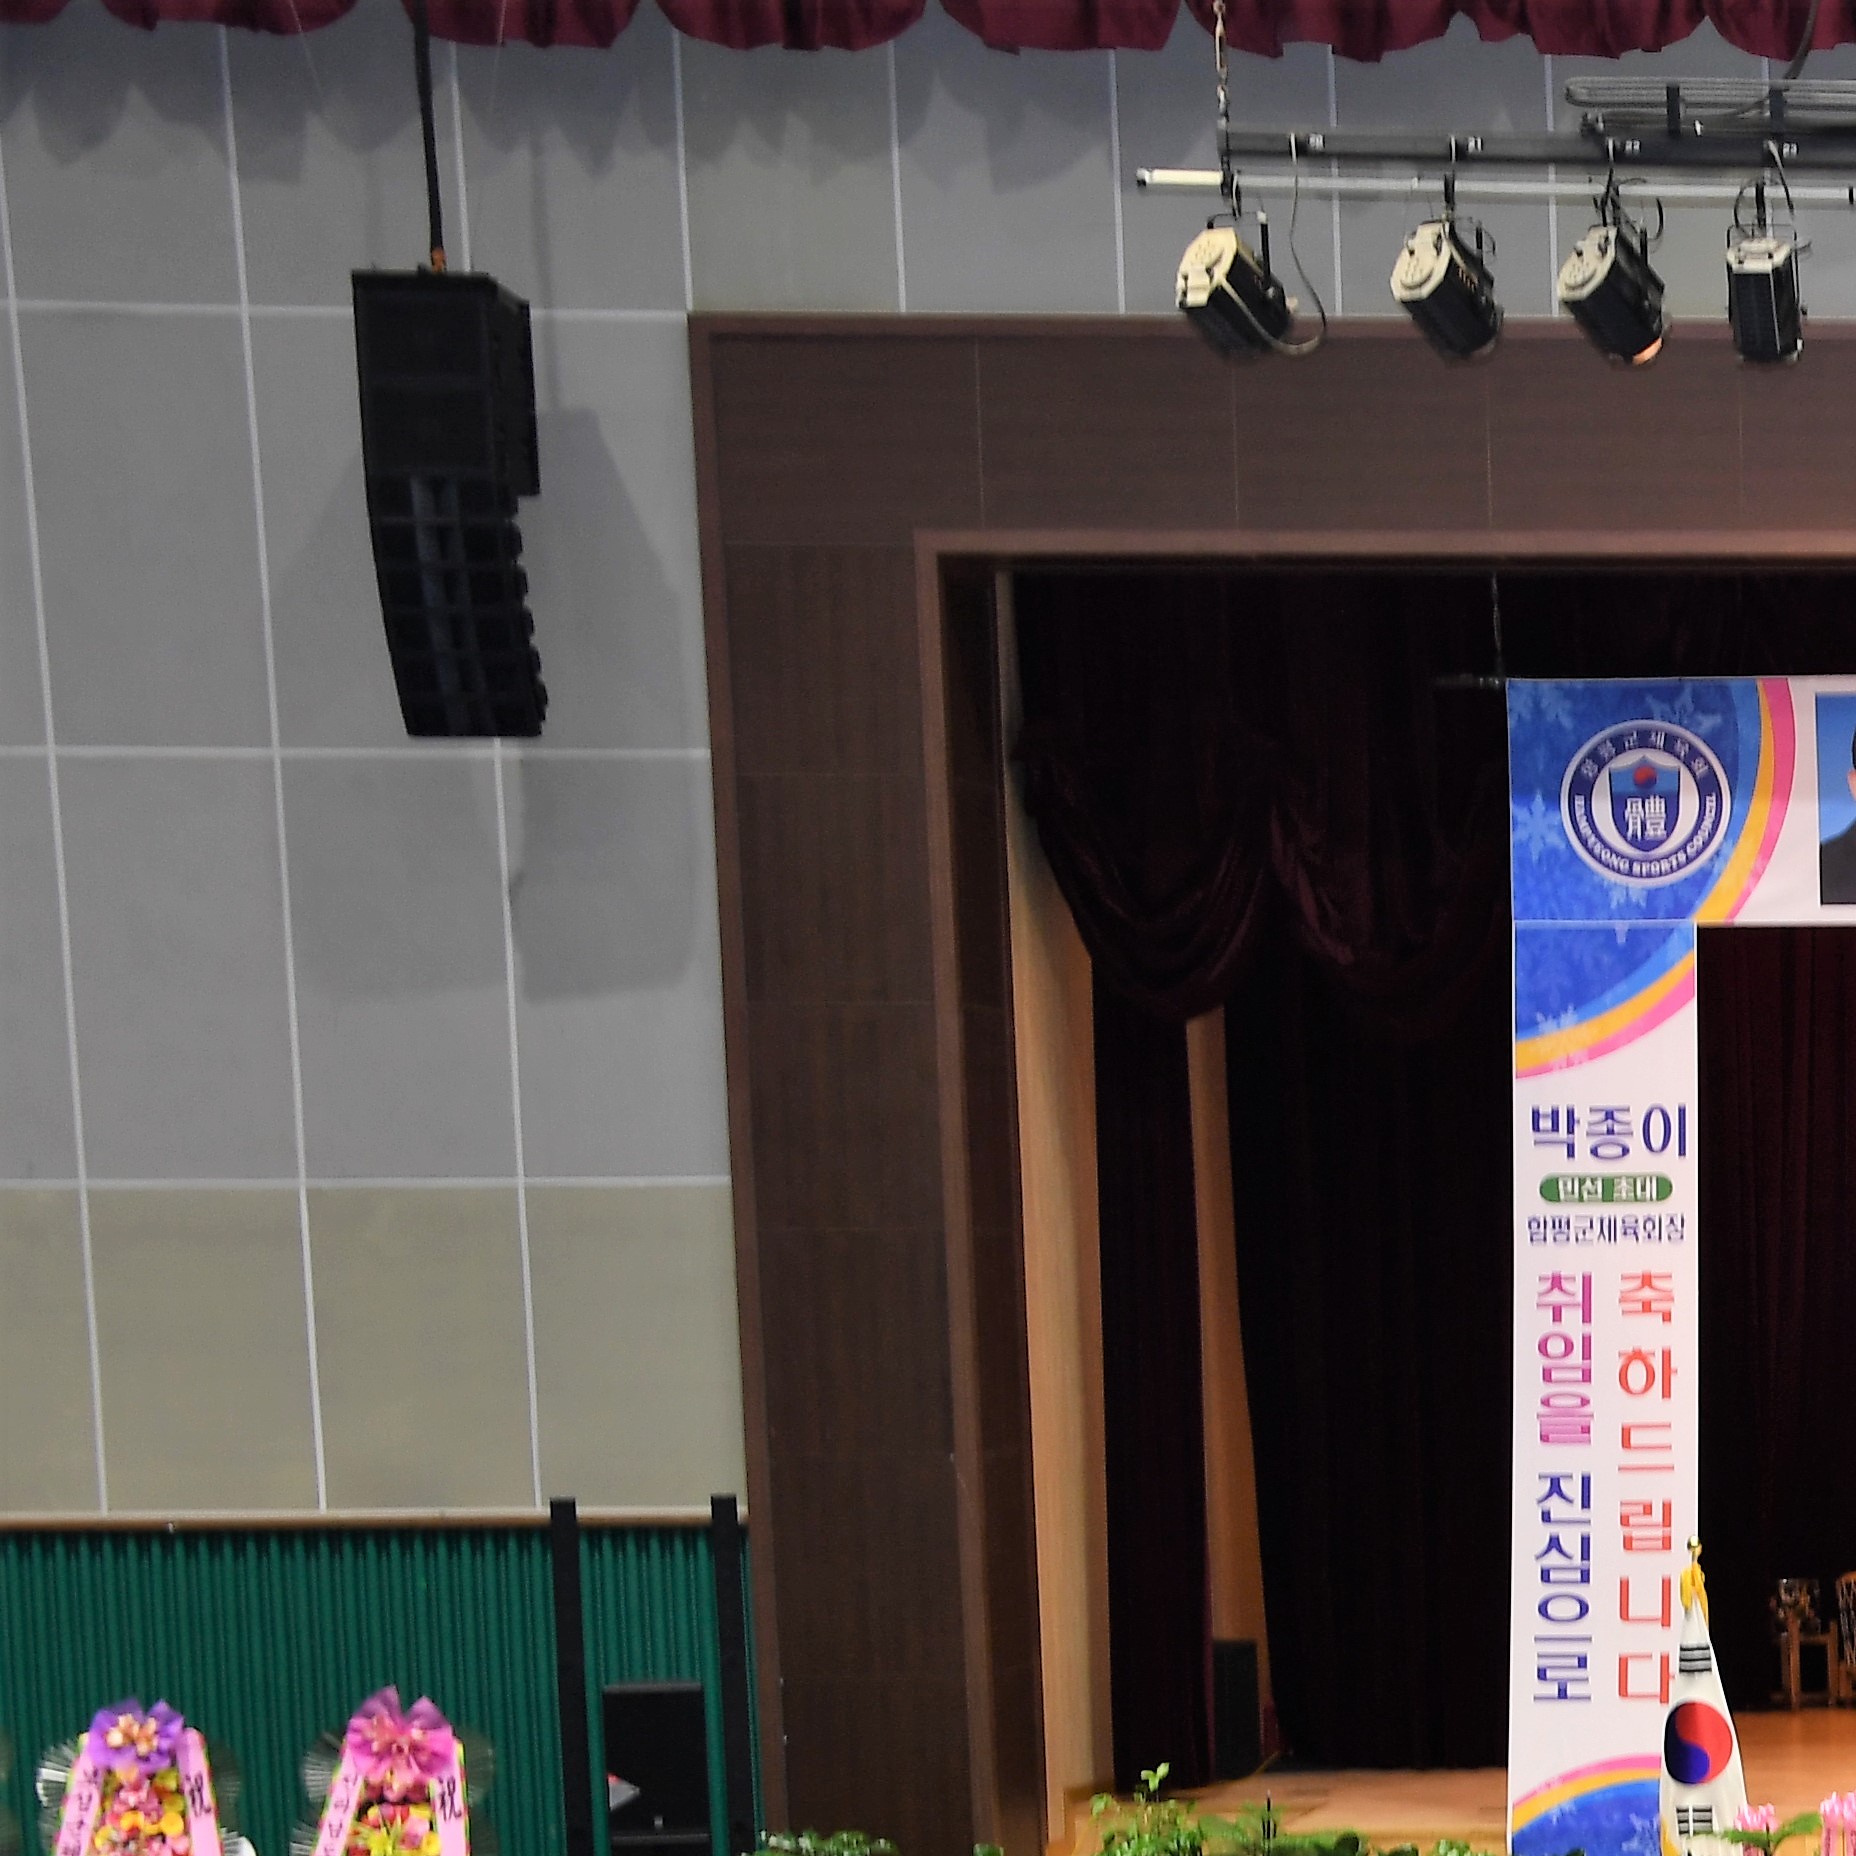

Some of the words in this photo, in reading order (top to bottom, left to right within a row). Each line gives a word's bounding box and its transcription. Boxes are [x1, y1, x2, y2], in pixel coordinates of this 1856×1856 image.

[1531, 1103, 1688, 1161] 박종이
[1557, 1176, 1603, 1200] 민선
[1536, 1271, 1594, 1445] 취임을
[1617, 1271, 1677, 1705] 축하드립니다
[1533, 1472, 1593, 1702] 진심으로
